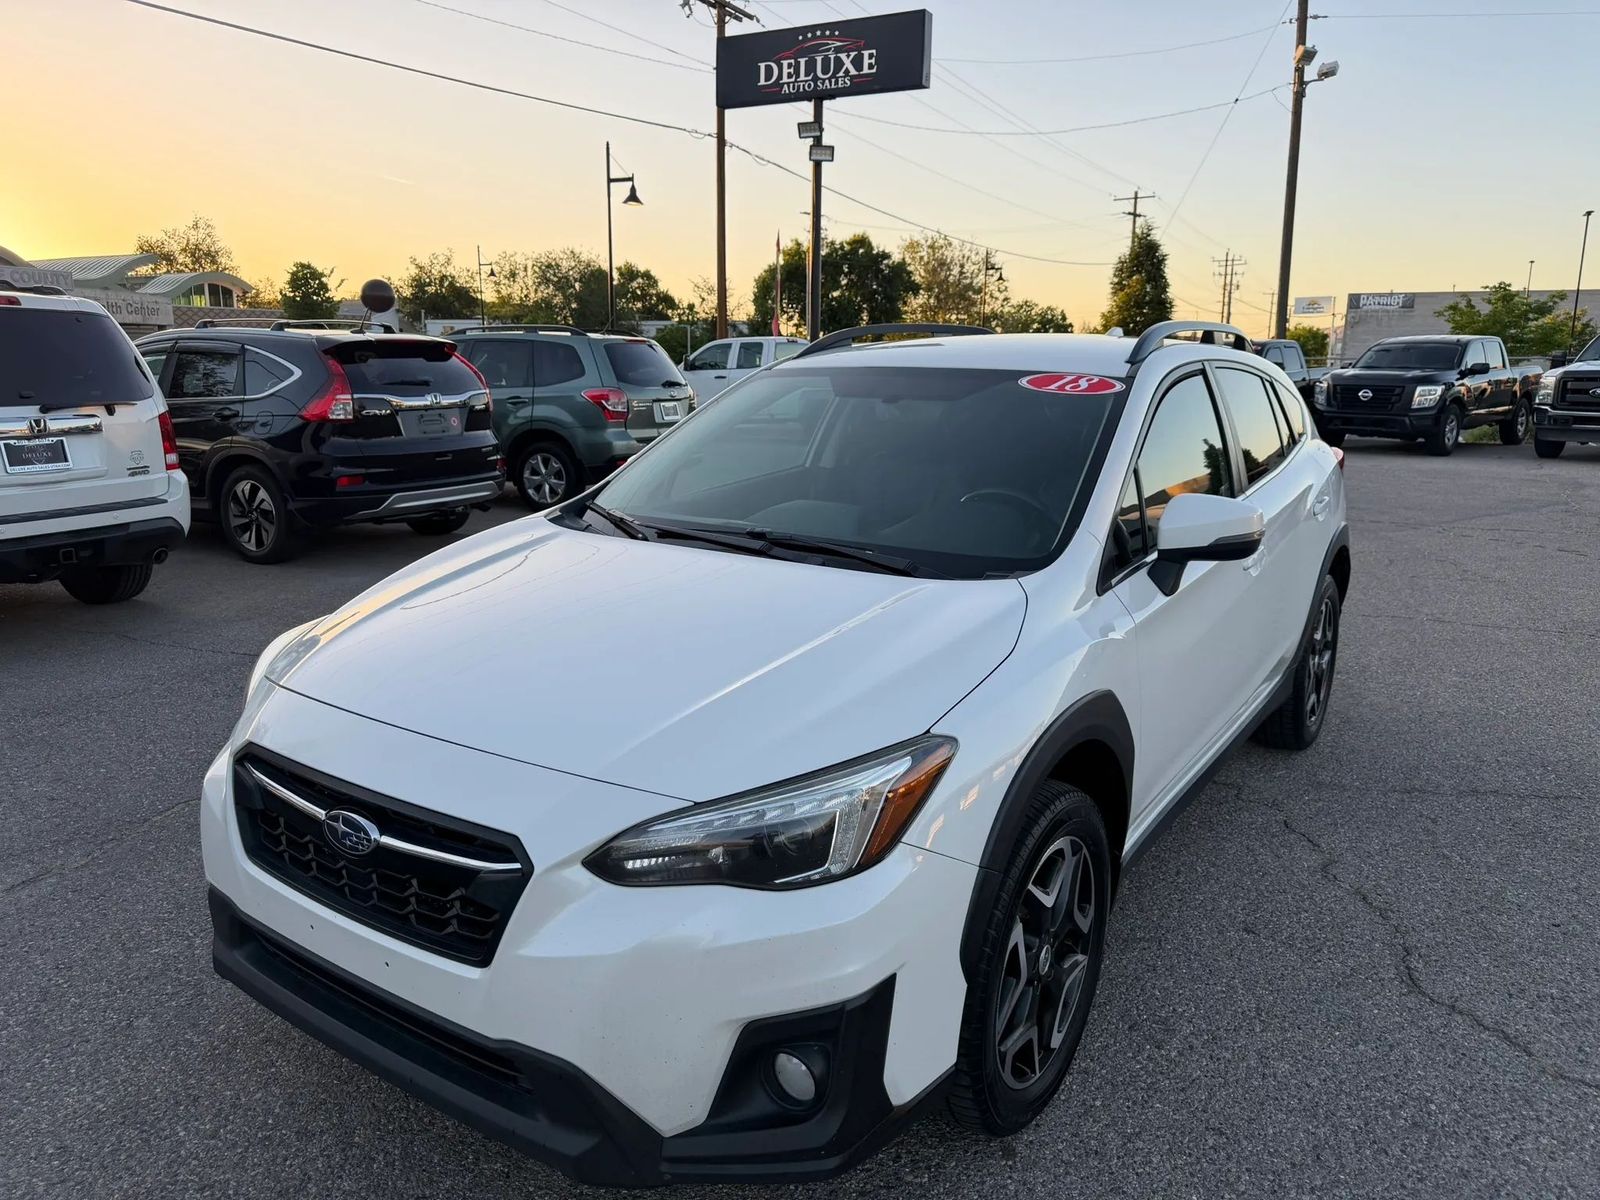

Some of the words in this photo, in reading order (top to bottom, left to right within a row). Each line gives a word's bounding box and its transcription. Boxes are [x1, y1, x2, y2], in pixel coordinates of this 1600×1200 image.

[757, 49, 878, 86] DELUXE
[781, 81, 814, 94] AUTO
[816, 76, 851, 91] SALES
[10, 269, 71, 288] COUNTY
[126, 302, 160, 317] Center
[1360, 294, 1405, 308] PATRIOT
[1042, 375, 1100, 391] 18
